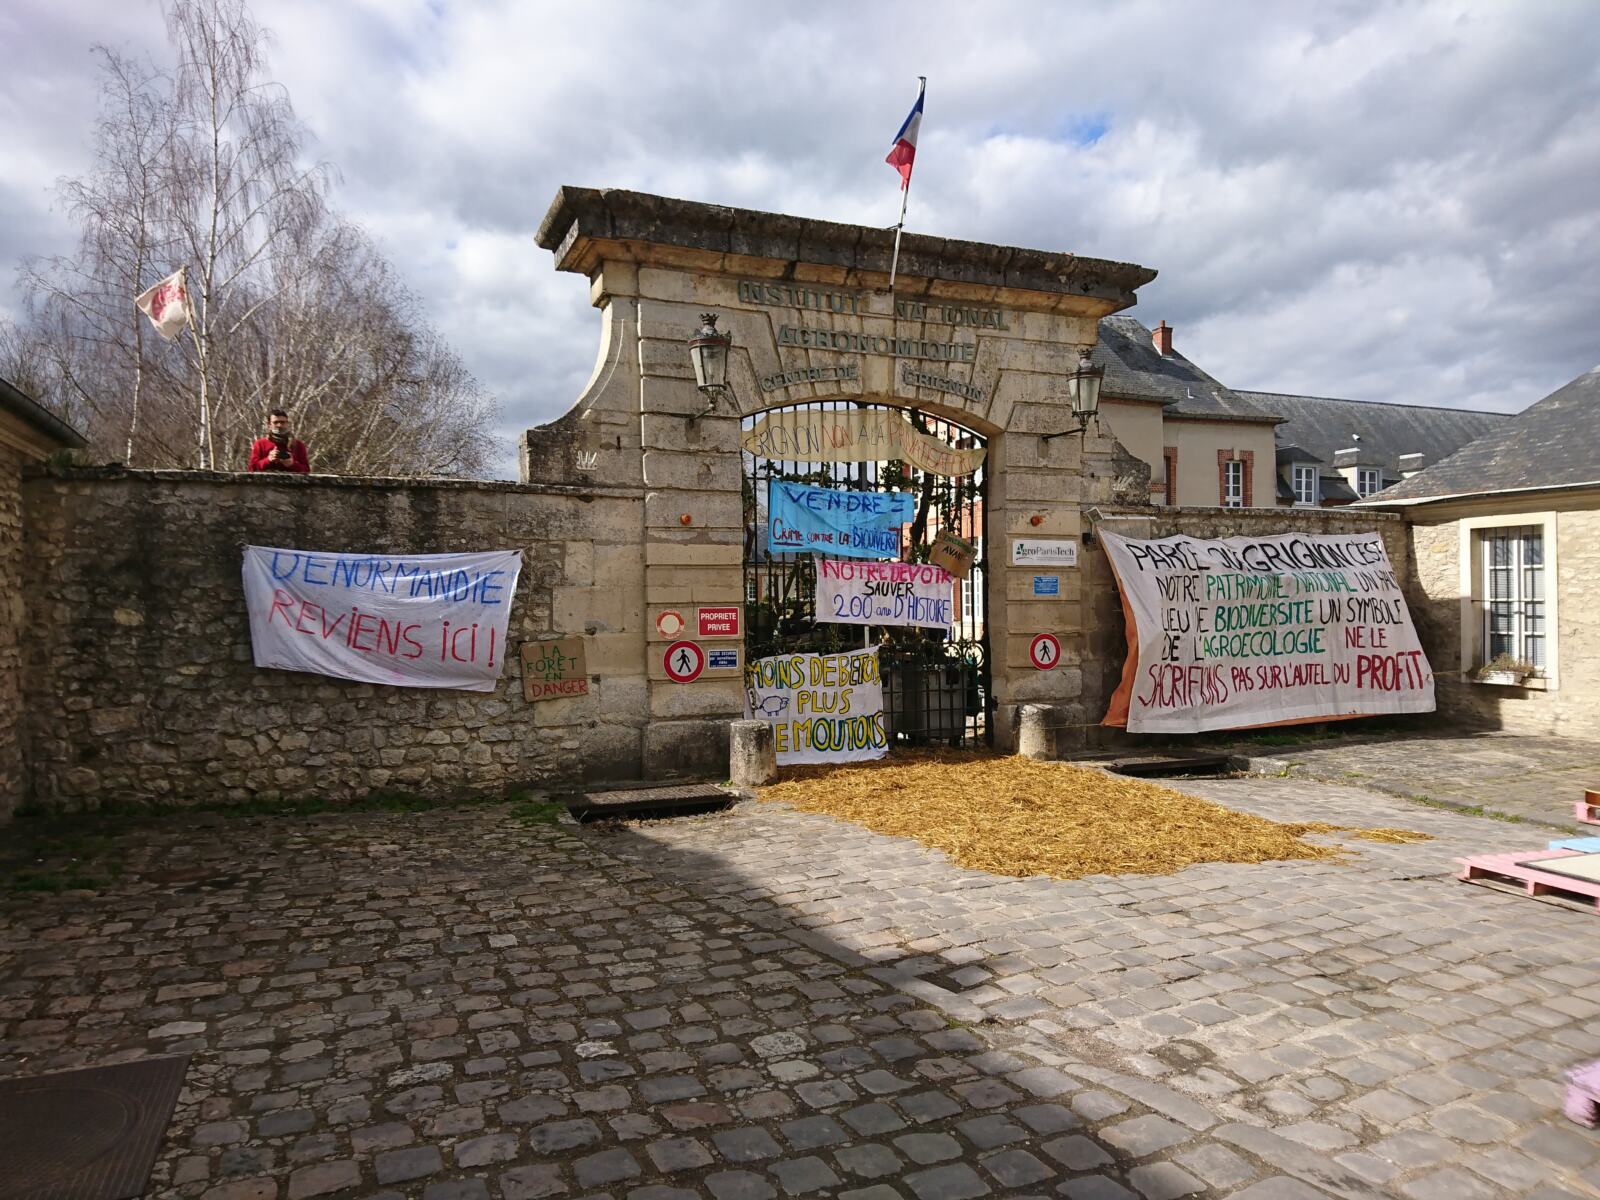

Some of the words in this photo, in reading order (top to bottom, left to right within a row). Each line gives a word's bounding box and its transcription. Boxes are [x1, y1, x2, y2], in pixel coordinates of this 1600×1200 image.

[738, 280, 859, 315] INSTITUT
[896, 301, 1010, 331] NAIONAL
[778, 325, 976, 363] AGRONOMIQUE
[761, 367, 825, 392] CENTRE
[834, 363, 858, 381] DE
[821, 423, 853, 449] NON
[858, 424, 869, 446] A
[784, 486, 886, 515] VENDRE
[838, 531, 849, 545] LA
[1016, 544, 1074, 556] AgroParisTech
[1126, 541, 1210, 571] PARCE
[1242, 540, 1354, 572] GRIGNON
[823, 561, 887, 581] NOTRE
[861, 580, 914, 597] SAUVER
[1155, 574, 1200, 602] NOTRE
[1354, 571, 1379, 592] UN
[834, 594, 873, 619] 200
[1215, 600, 1314, 633] BIODIVERSITE
[1320, 598, 1340, 625] UN
[1346, 597, 1403, 625] SYMBOLE
[542, 645, 561, 659] LA
[1161, 632, 1180, 661] DE
[1346, 626, 1366, 648] NE
[1371, 628, 1388, 648] LE
[545, 672, 562, 682] EN
[810, 656, 836, 687] DE
[1231, 665, 1254, 693] PAS
[1257, 664, 1283, 690] SUR
[1284, 662, 1331, 688] L'AUTEL
[1334, 662, 1349, 684] DU
[532, 679, 587, 698] DANGER
[797, 688, 853, 714] PLUS
[775, 723, 789, 753] E
[793, 710, 887, 752] MOUTONS
